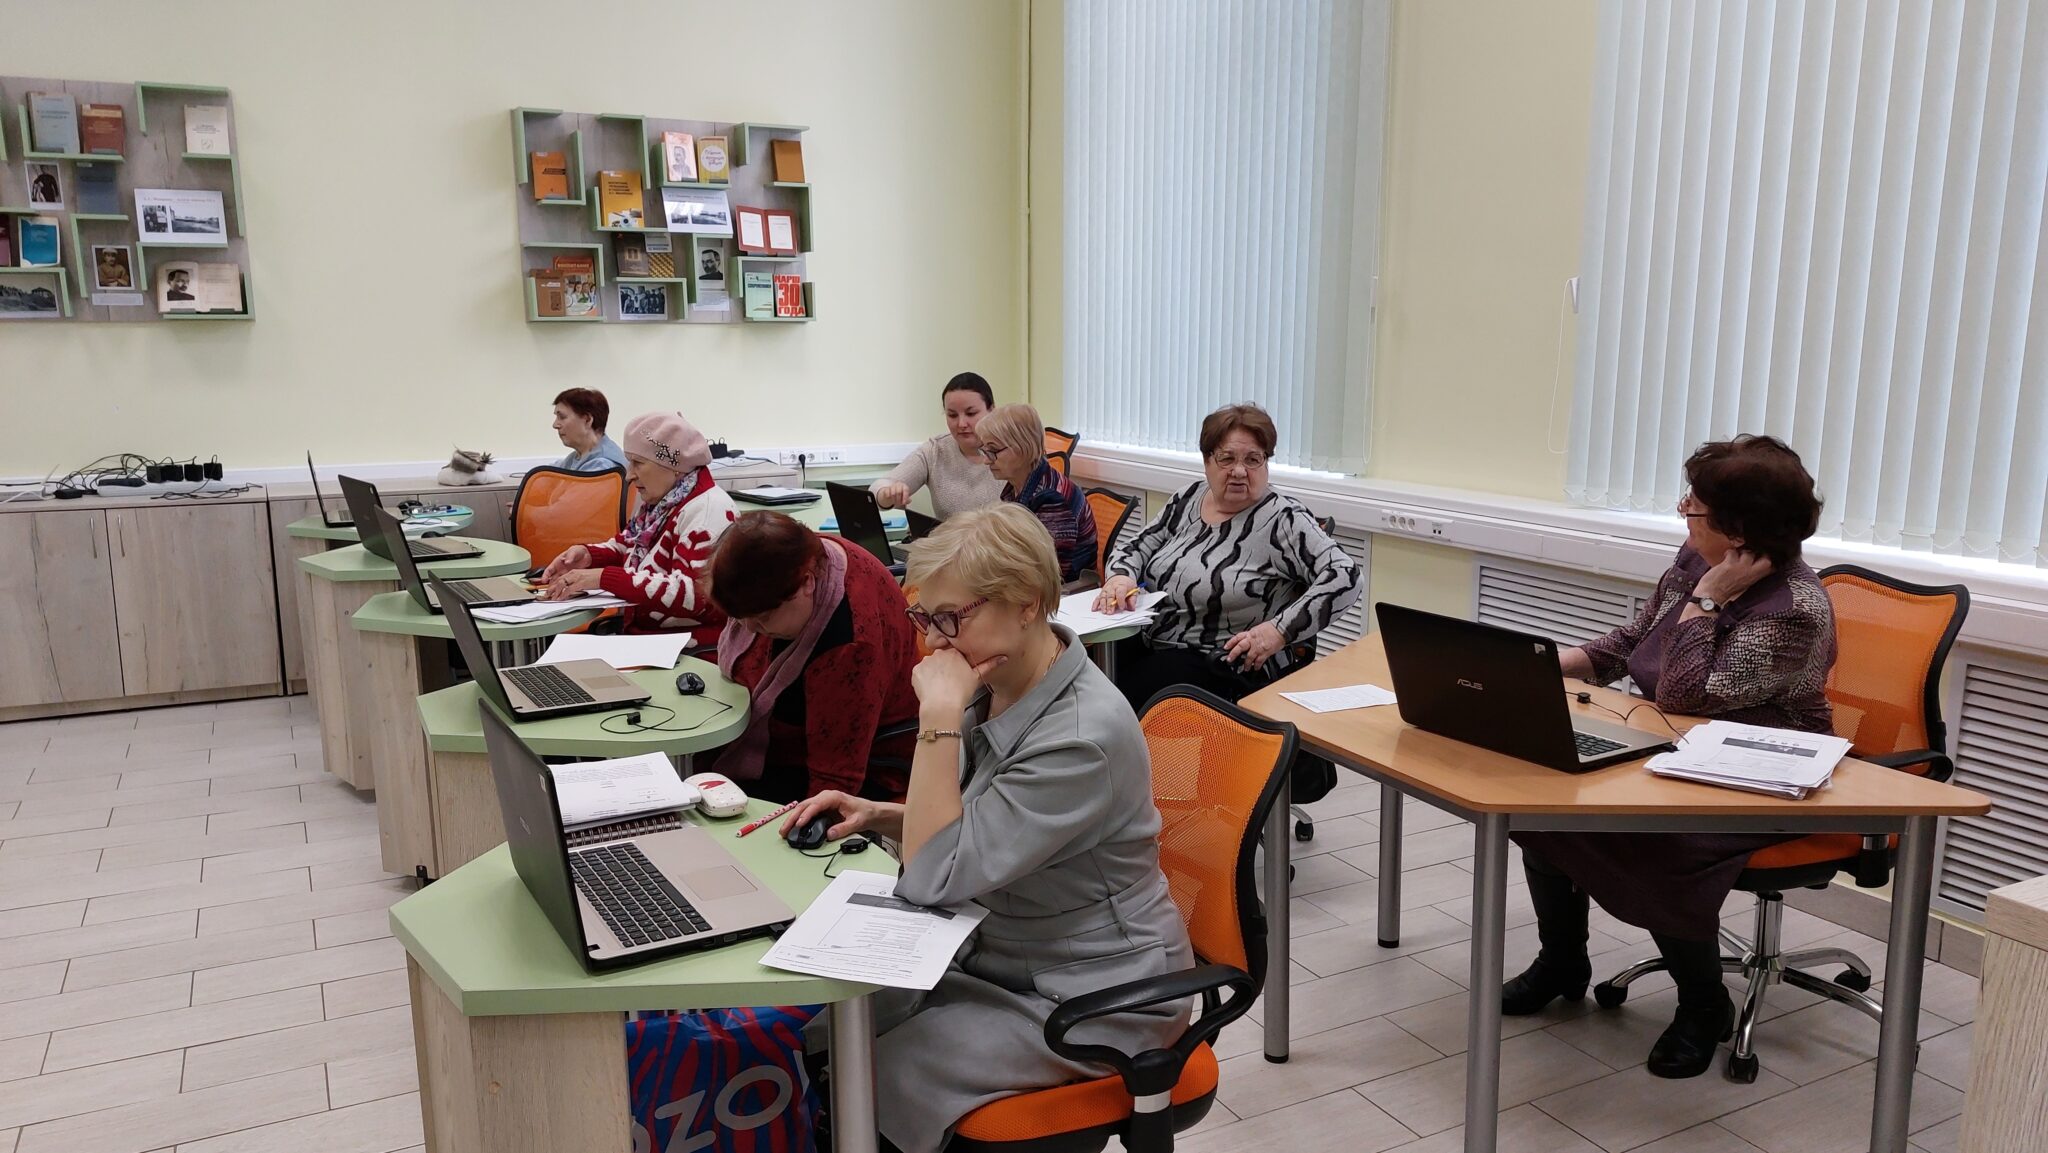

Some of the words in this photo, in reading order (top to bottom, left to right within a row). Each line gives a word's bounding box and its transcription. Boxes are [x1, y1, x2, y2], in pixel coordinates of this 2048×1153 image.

[774, 275, 800, 283] МАРШ
[778, 283, 800, 307] 30
[778, 306, 805, 316] ГОДА
